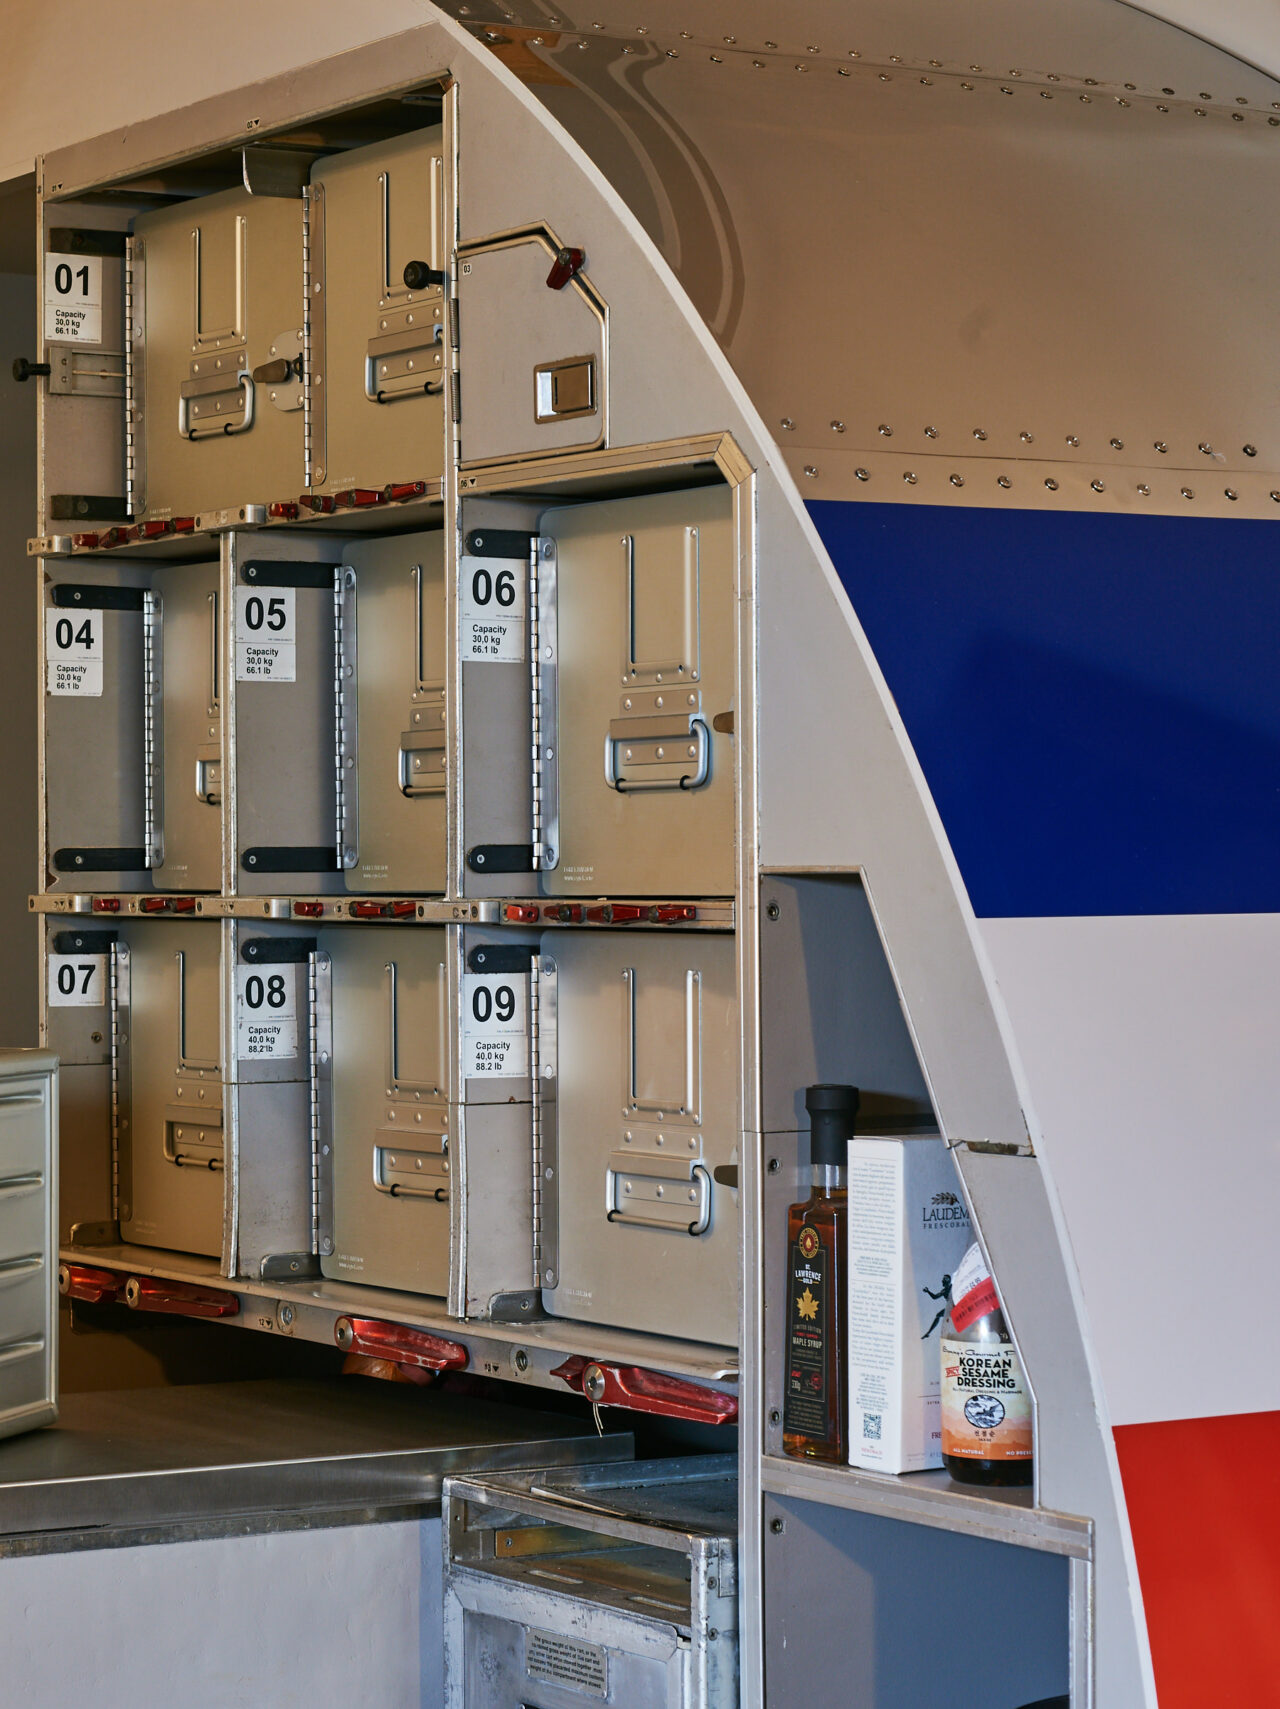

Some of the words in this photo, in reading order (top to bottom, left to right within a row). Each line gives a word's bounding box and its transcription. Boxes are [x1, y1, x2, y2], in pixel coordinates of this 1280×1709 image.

[463, 264, 470, 273] 03
[55, 263, 89, 296] 01
[56, 310, 86, 320] Capacity
[55, 318, 70, 326] 30,0
[71, 320, 81, 328] kg
[472, 569, 515, 607] 06
[245, 597, 286, 631] 05
[56, 618, 95, 649] 04
[472, 624, 507, 635] Capacity
[472, 635, 489, 643] 30,0
[491, 635, 501, 645] kg
[246, 647, 279, 657] Capacity
[472, 645, 488, 653] 66.1
[491, 646, 499, 654] lb
[246, 657, 262, 665] 30,0
[263, 657, 273, 666] kg
[56, 664, 87, 674] Capacity
[56, 673, 71, 681] 30,0
[72, 674, 82, 682] kg
[57, 964, 96, 995] 07
[245, 974, 286, 1009] 08
[472, 985, 515, 1022] 09
[248, 1026, 281, 1035] Capacity
[248, 1035, 264, 1044] 40,0
[265, 1035, 275, 1044] kg
[248, 1045, 264, 1053] 88.2
[475, 1041, 511, 1051] Capacity
[475, 1052, 492, 1060] 40,0
[494, 1052, 505, 1061] kg
[475, 1062, 492, 1071] 88.2
[494, 1062, 502, 1070] lb
[795, 1269, 822, 1281] LAWRENCE
[792, 1336, 807, 1347] MAPLE
[807, 1338, 823, 1349] SYRUP
[959, 1357, 1012, 1368] KOREAN
[962, 1367, 1009, 1378] SESAME
[957, 1377, 1016, 1388] DRESSING
